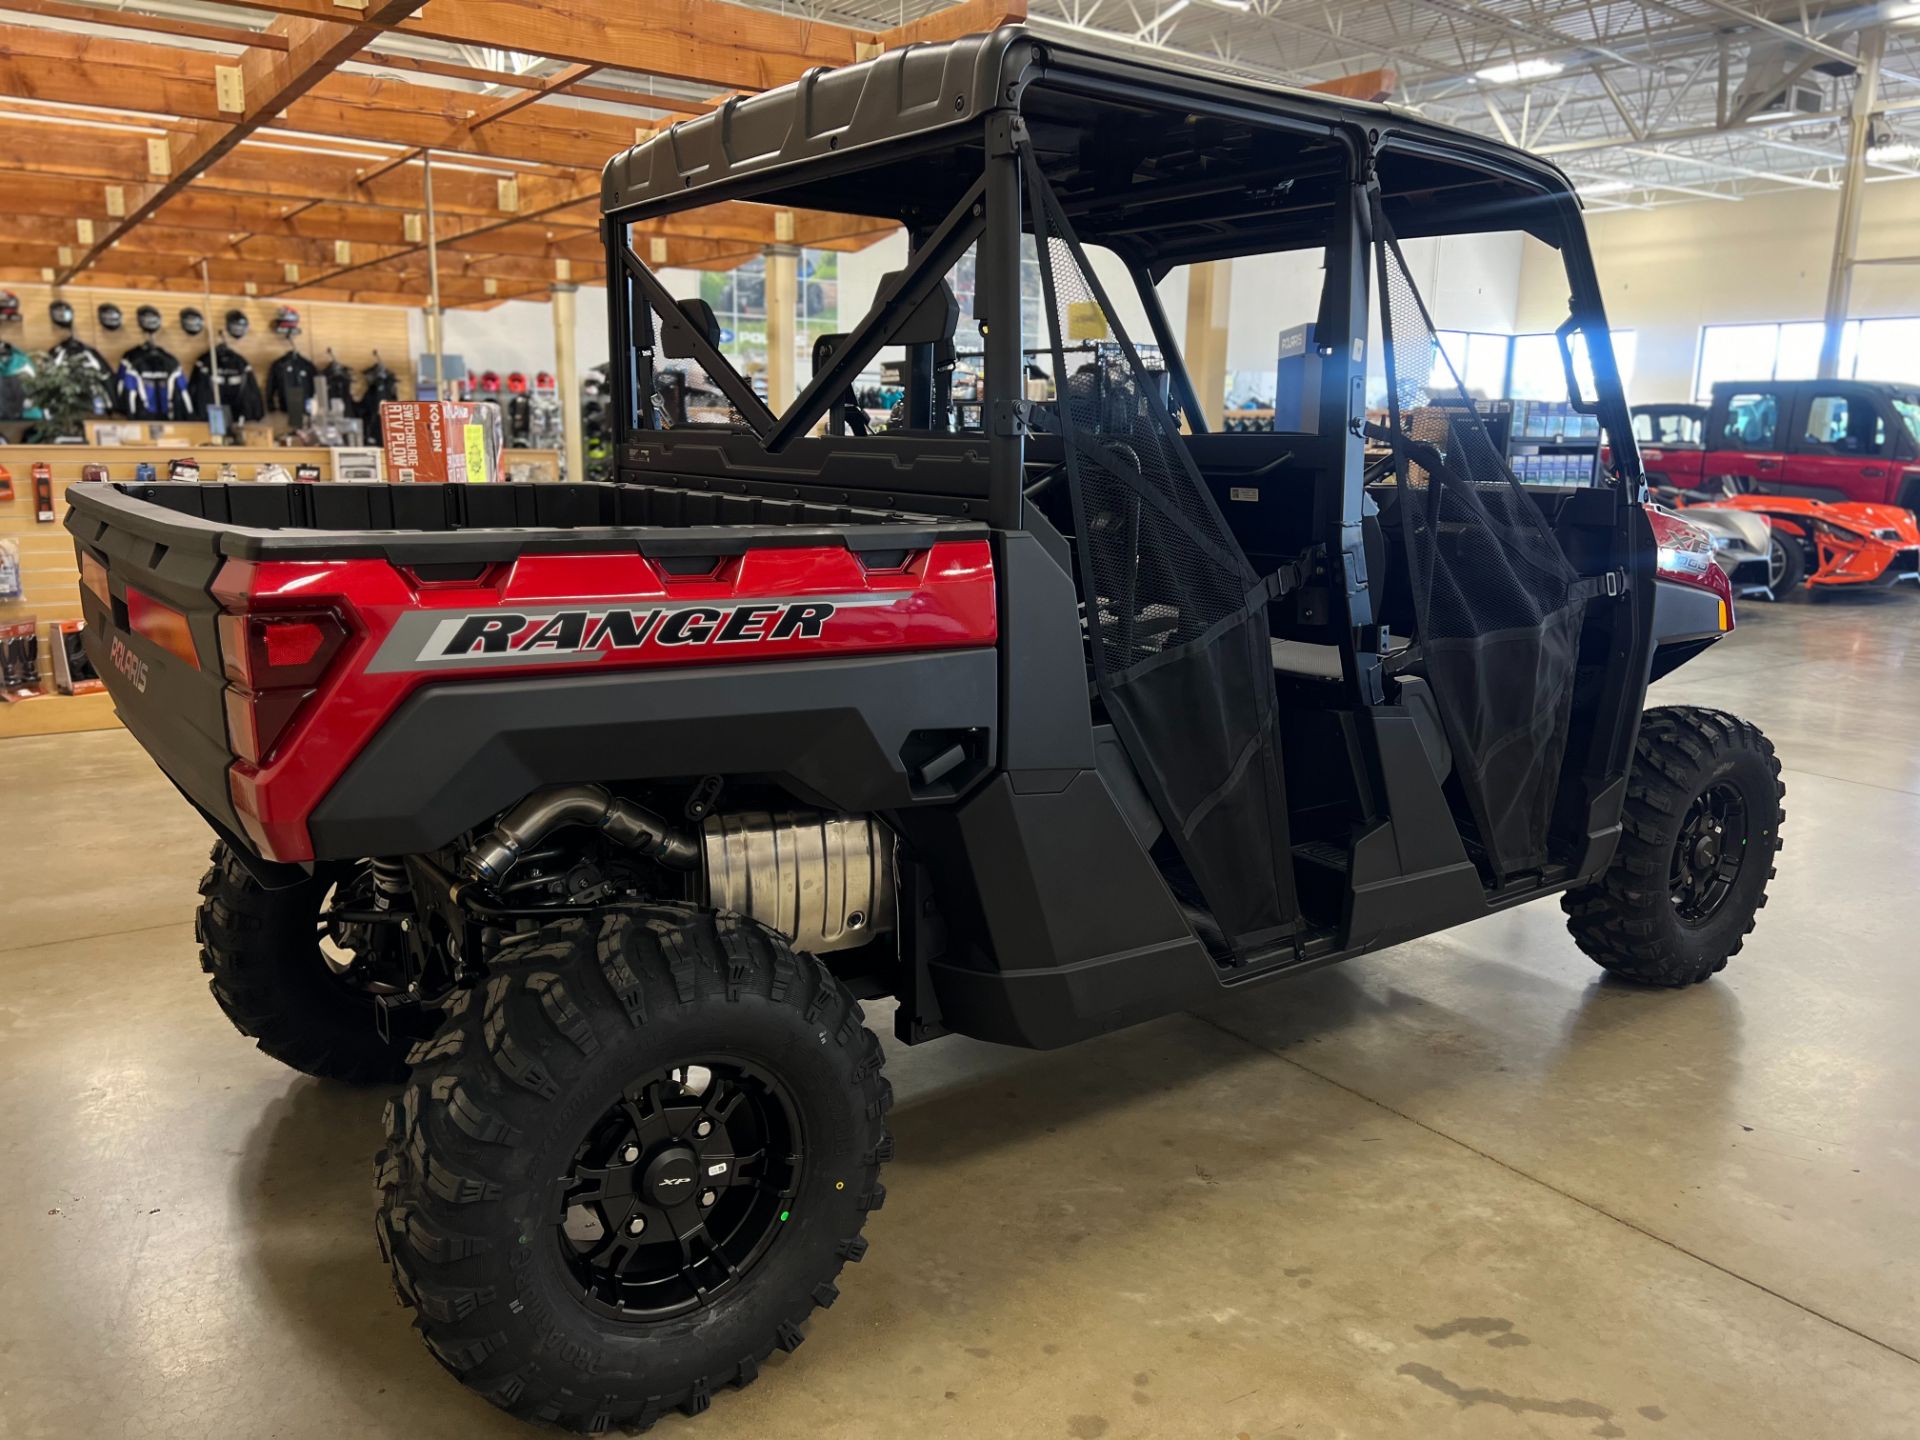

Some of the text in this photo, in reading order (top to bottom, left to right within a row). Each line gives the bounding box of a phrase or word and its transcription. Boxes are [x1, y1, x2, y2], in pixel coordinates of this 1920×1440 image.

[387, 404, 404, 430] ATV
[402, 404, 419, 467] SWITCHBLADE
[430, 404, 442, 453] KOLPIN
[390, 432, 408, 467] PLOW
[441, 601, 836, 657] RANGER
[109, 635, 149, 694] POLARIS
[658, 1177, 691, 1187] XP
